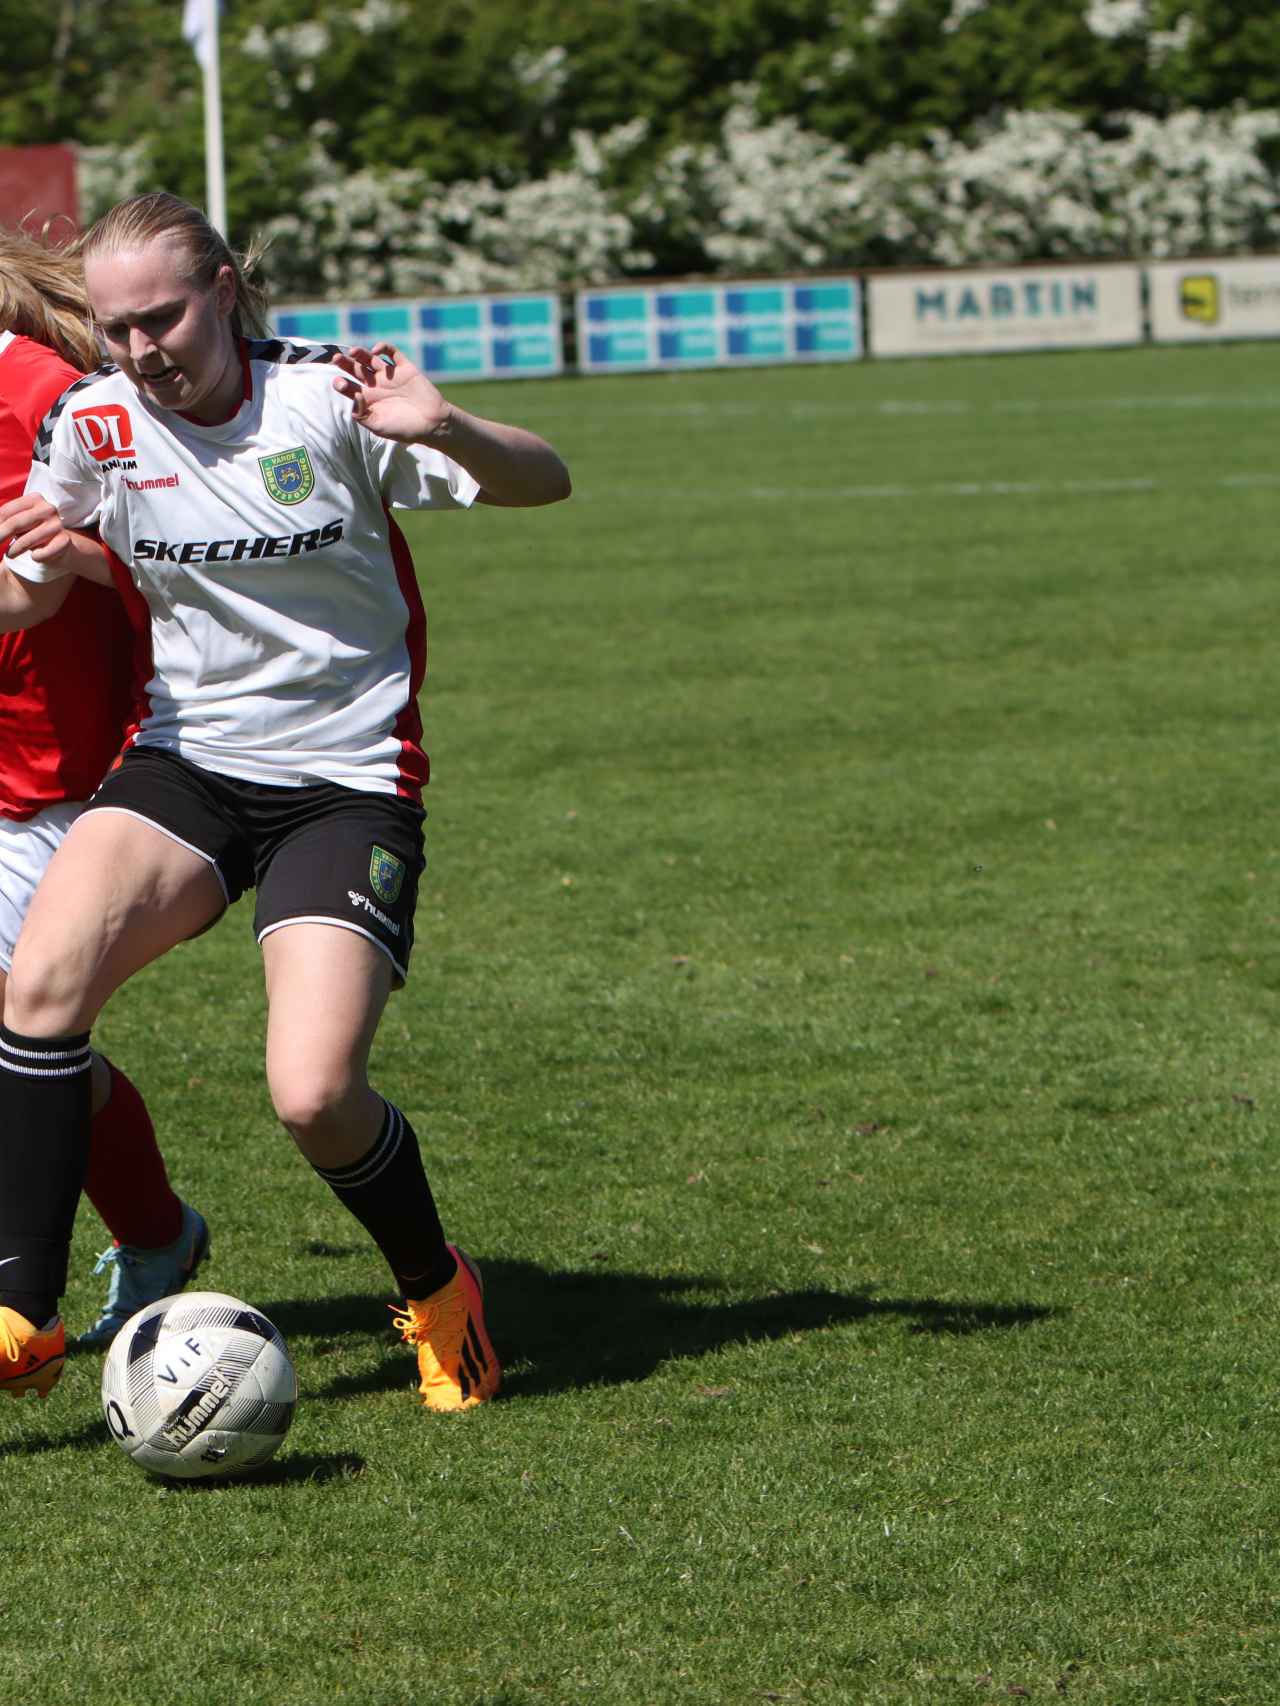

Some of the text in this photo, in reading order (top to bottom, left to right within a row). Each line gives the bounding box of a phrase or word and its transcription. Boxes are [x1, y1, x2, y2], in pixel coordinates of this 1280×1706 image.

[914, 280, 1098, 319] MARTIN
[125, 473, 180, 491] hummel
[133, 518, 344, 564] SKECHERS
[162, 1367, 233, 1449] hummel
